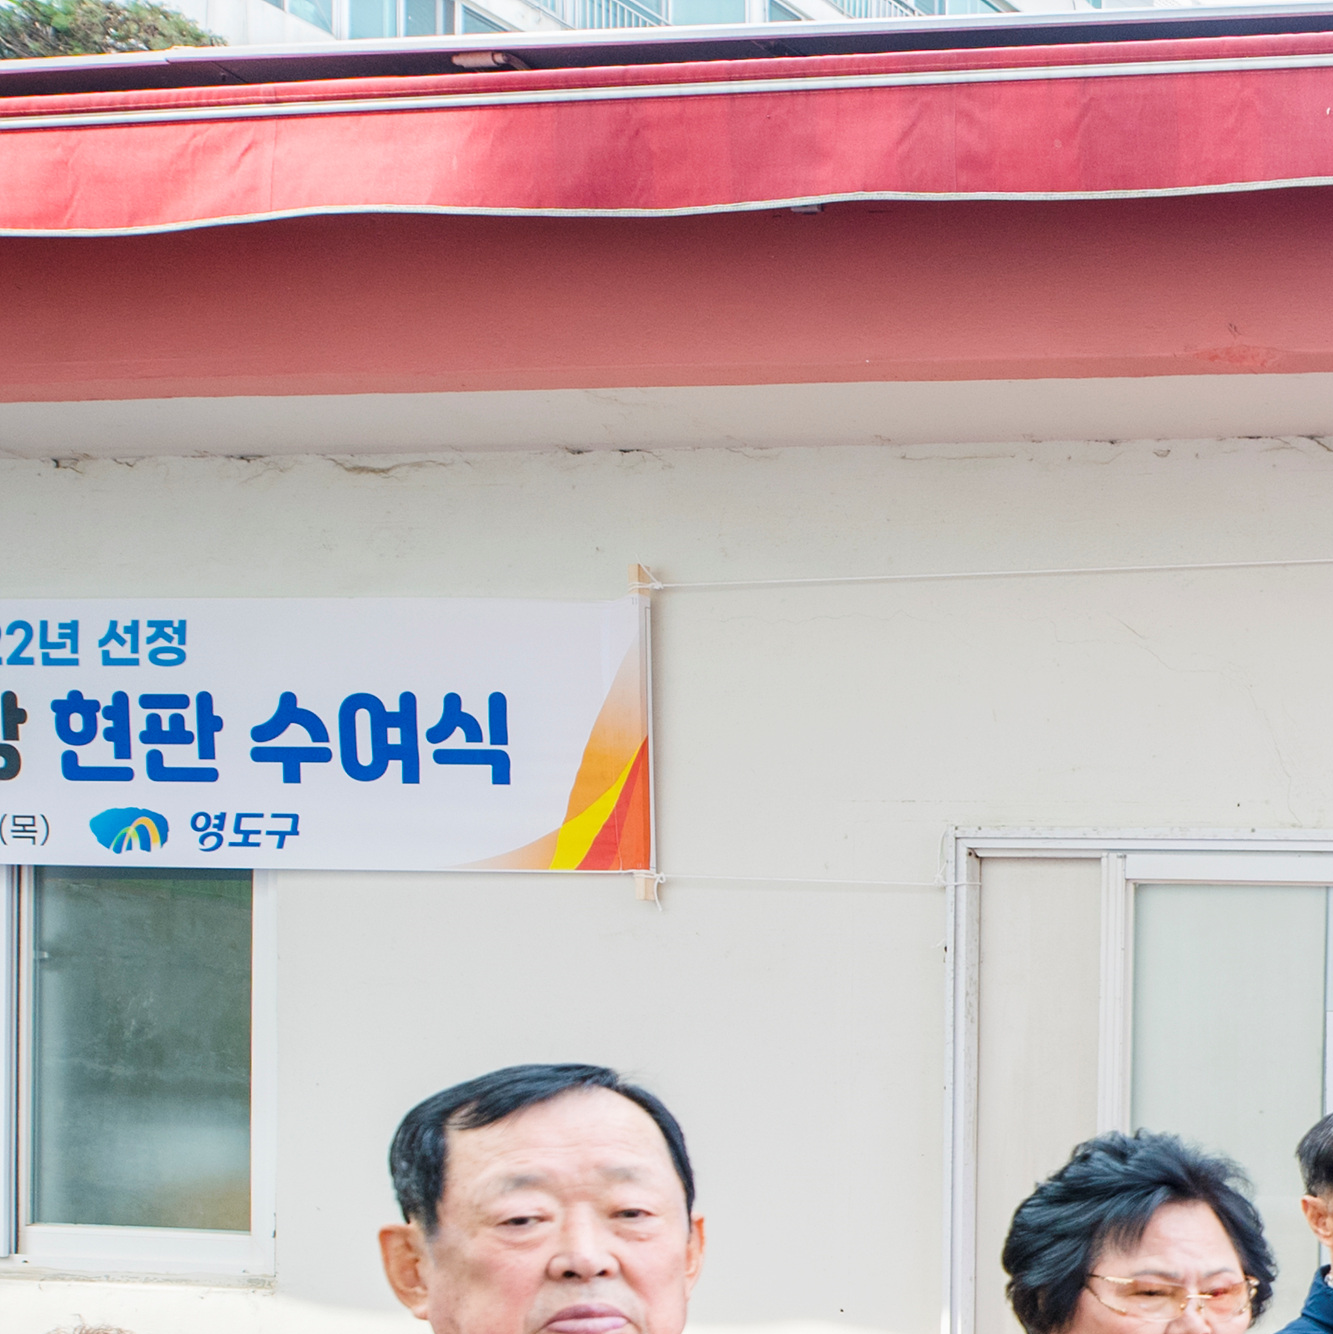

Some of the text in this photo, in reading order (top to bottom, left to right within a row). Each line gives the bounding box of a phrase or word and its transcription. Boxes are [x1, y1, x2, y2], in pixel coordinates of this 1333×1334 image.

[0, 619, 188, 667] 2년 선정
[50, 689, 224, 783] 현판
[249, 690, 512, 786] 수여식
[189, 811, 301, 852] 영도구
